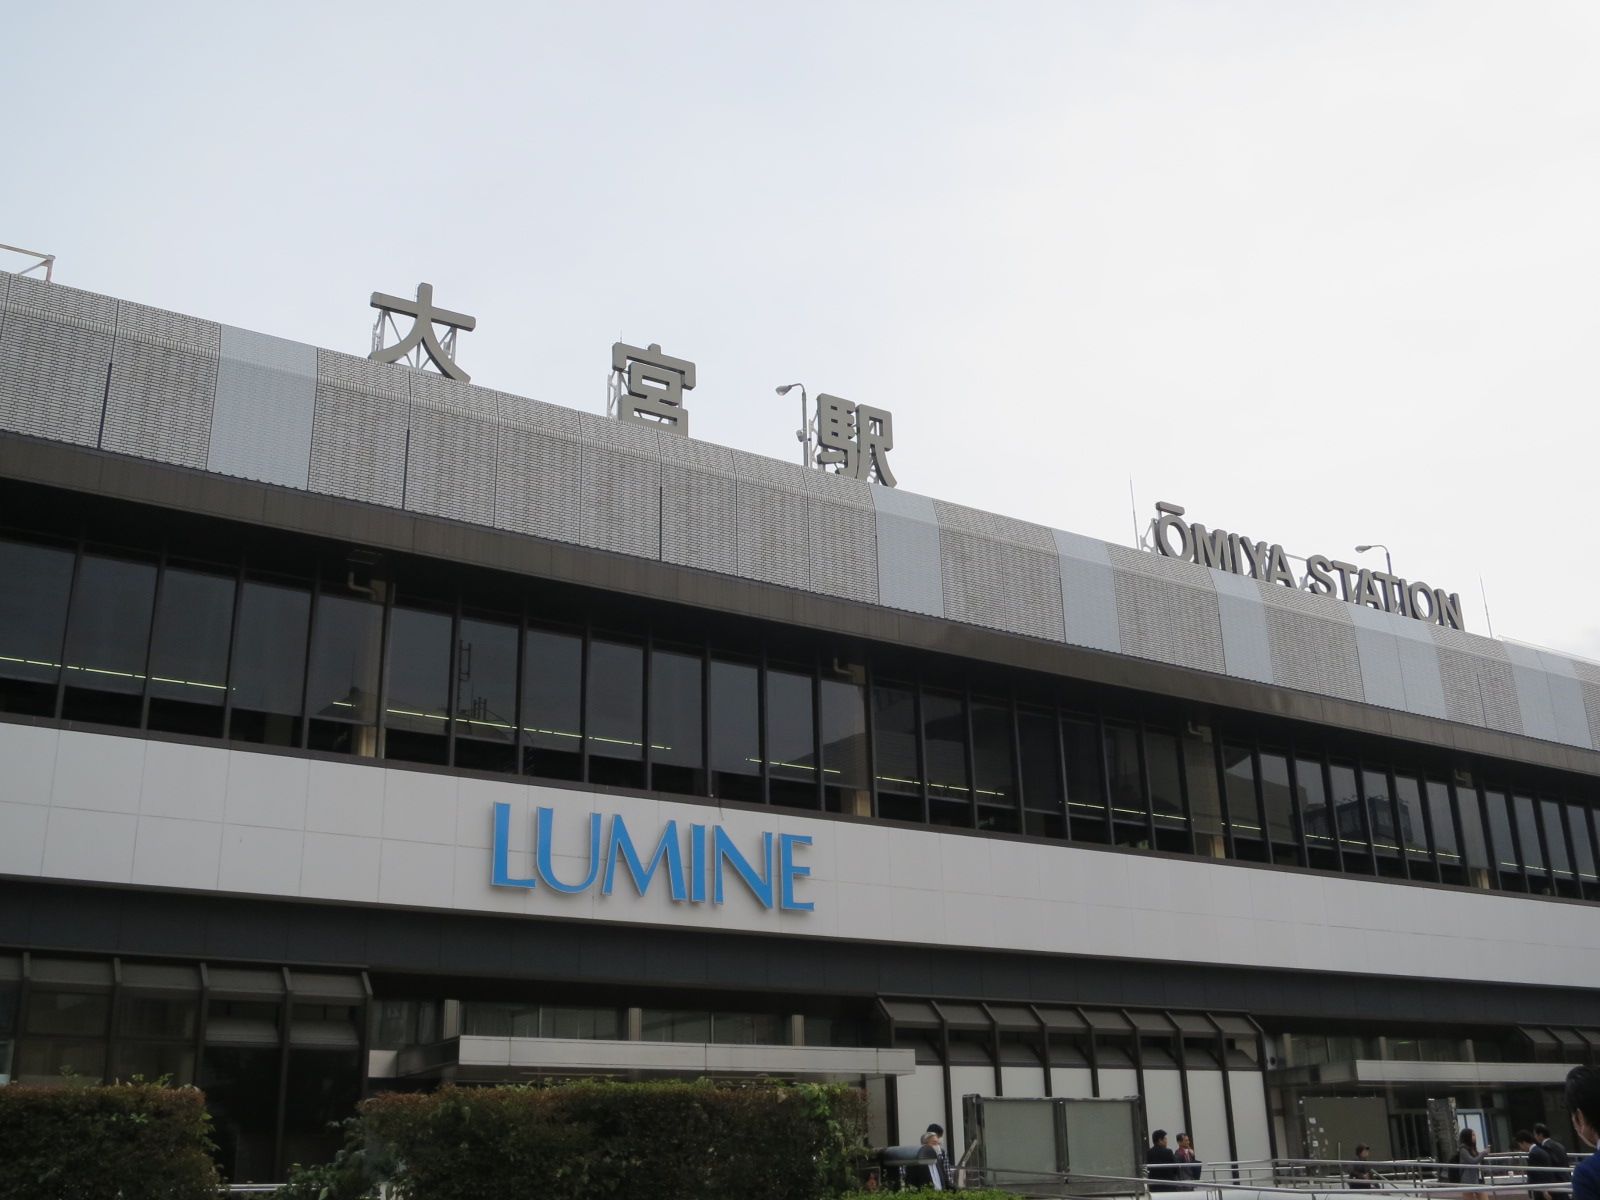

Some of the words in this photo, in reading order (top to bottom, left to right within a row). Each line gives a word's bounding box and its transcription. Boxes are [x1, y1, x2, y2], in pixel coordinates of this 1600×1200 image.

[368, 282, 897, 487] 大宮駅
[1155, 501, 1298, 590] ŌMIYA
[1305, 554, 1466, 633] STATION
[490, 801, 815, 912] LUMINE
